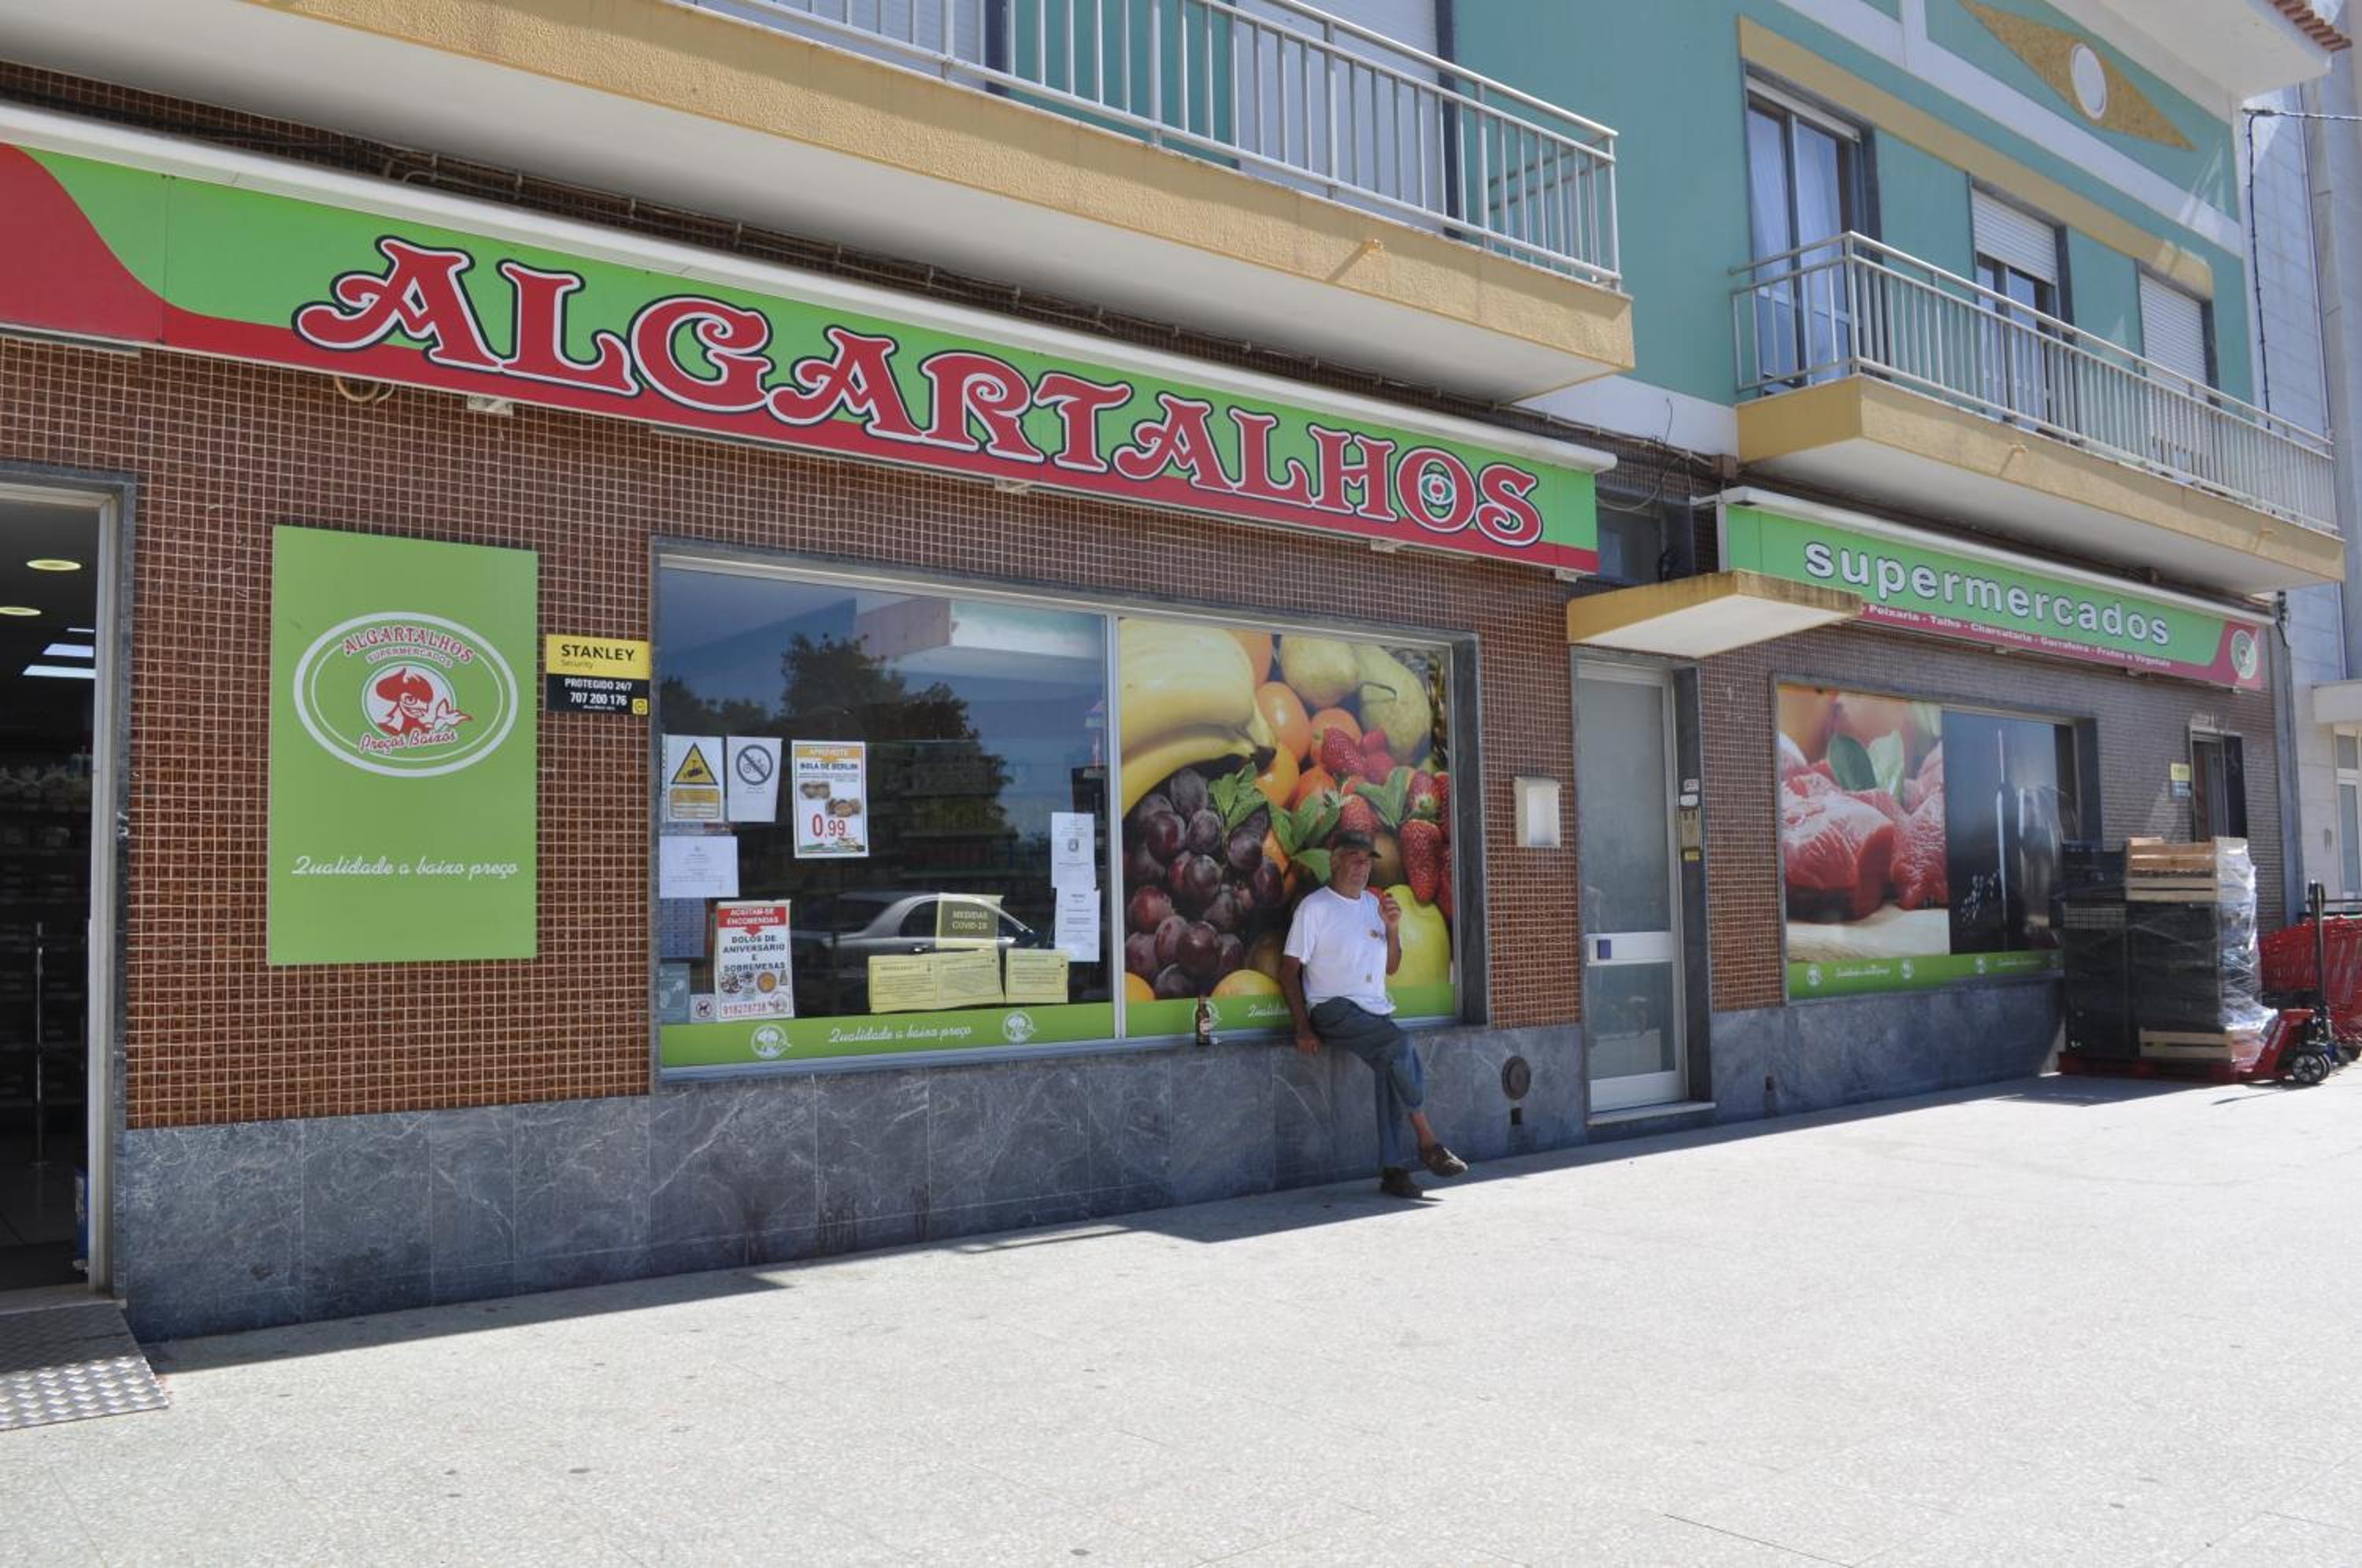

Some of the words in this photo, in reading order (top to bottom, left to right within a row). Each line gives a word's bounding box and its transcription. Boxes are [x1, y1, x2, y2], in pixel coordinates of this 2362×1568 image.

[291, 235, 1543, 548] ALGARTALHOS
[1804, 541, 2171, 646] supermercados
[1931, 616, 1961, 629] Talho
[343, 624, 476, 663] ALGARTALHOS
[561, 643, 635, 662] STANLEY
[365, 645, 453, 668] SUPERMERCADOS
[565, 678, 614, 690] PROTEGIDO
[615, 681, 632, 691] 24/7
[569, 692, 587, 704] 707
[590, 693, 608, 705] 200
[609, 694, 628, 706] 176
[360, 734, 404, 753] Preços
[409, 728, 457, 746] Baixos
[812, 813, 846, 838] 0,99
[416, 856, 465, 875] baixo
[468, 863, 518, 880] preço
[724, 961, 785, 972] SOBREMESAS
